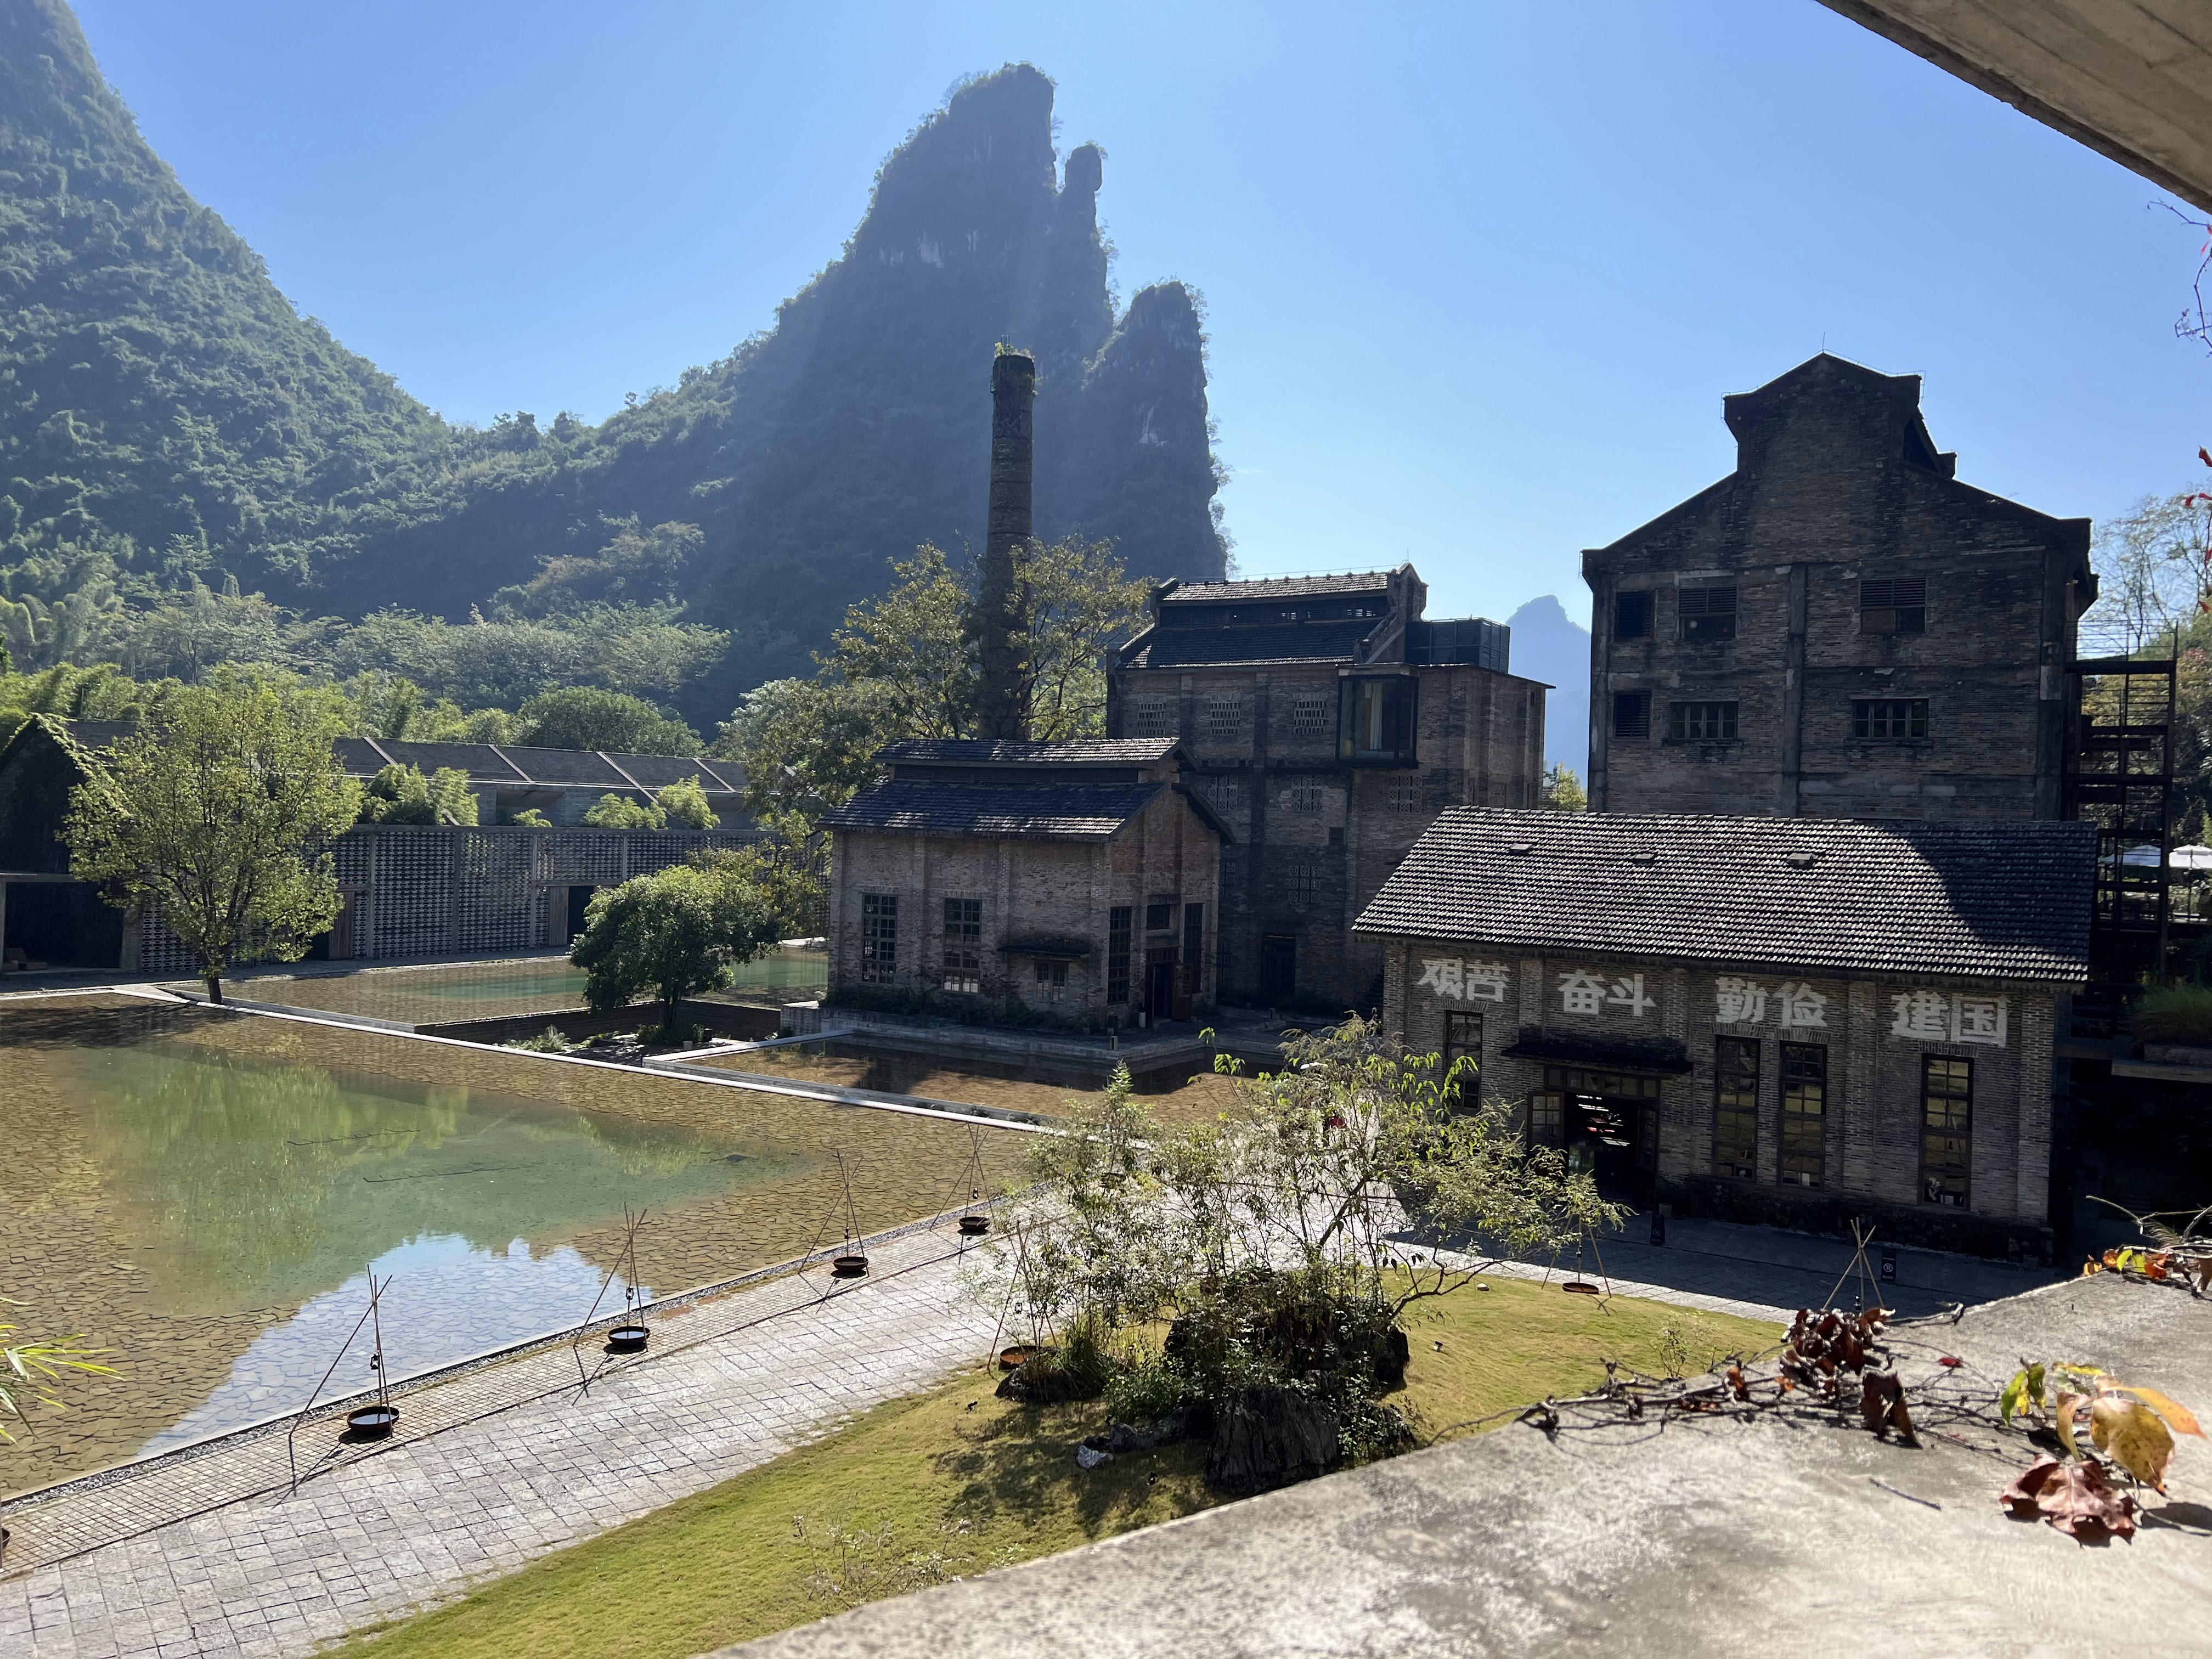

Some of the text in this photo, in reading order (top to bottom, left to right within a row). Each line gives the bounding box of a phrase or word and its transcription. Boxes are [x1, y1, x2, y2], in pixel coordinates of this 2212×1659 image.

[1418, 957, 2011, 1047] 艰苦 奋斗 勤俭 建国
